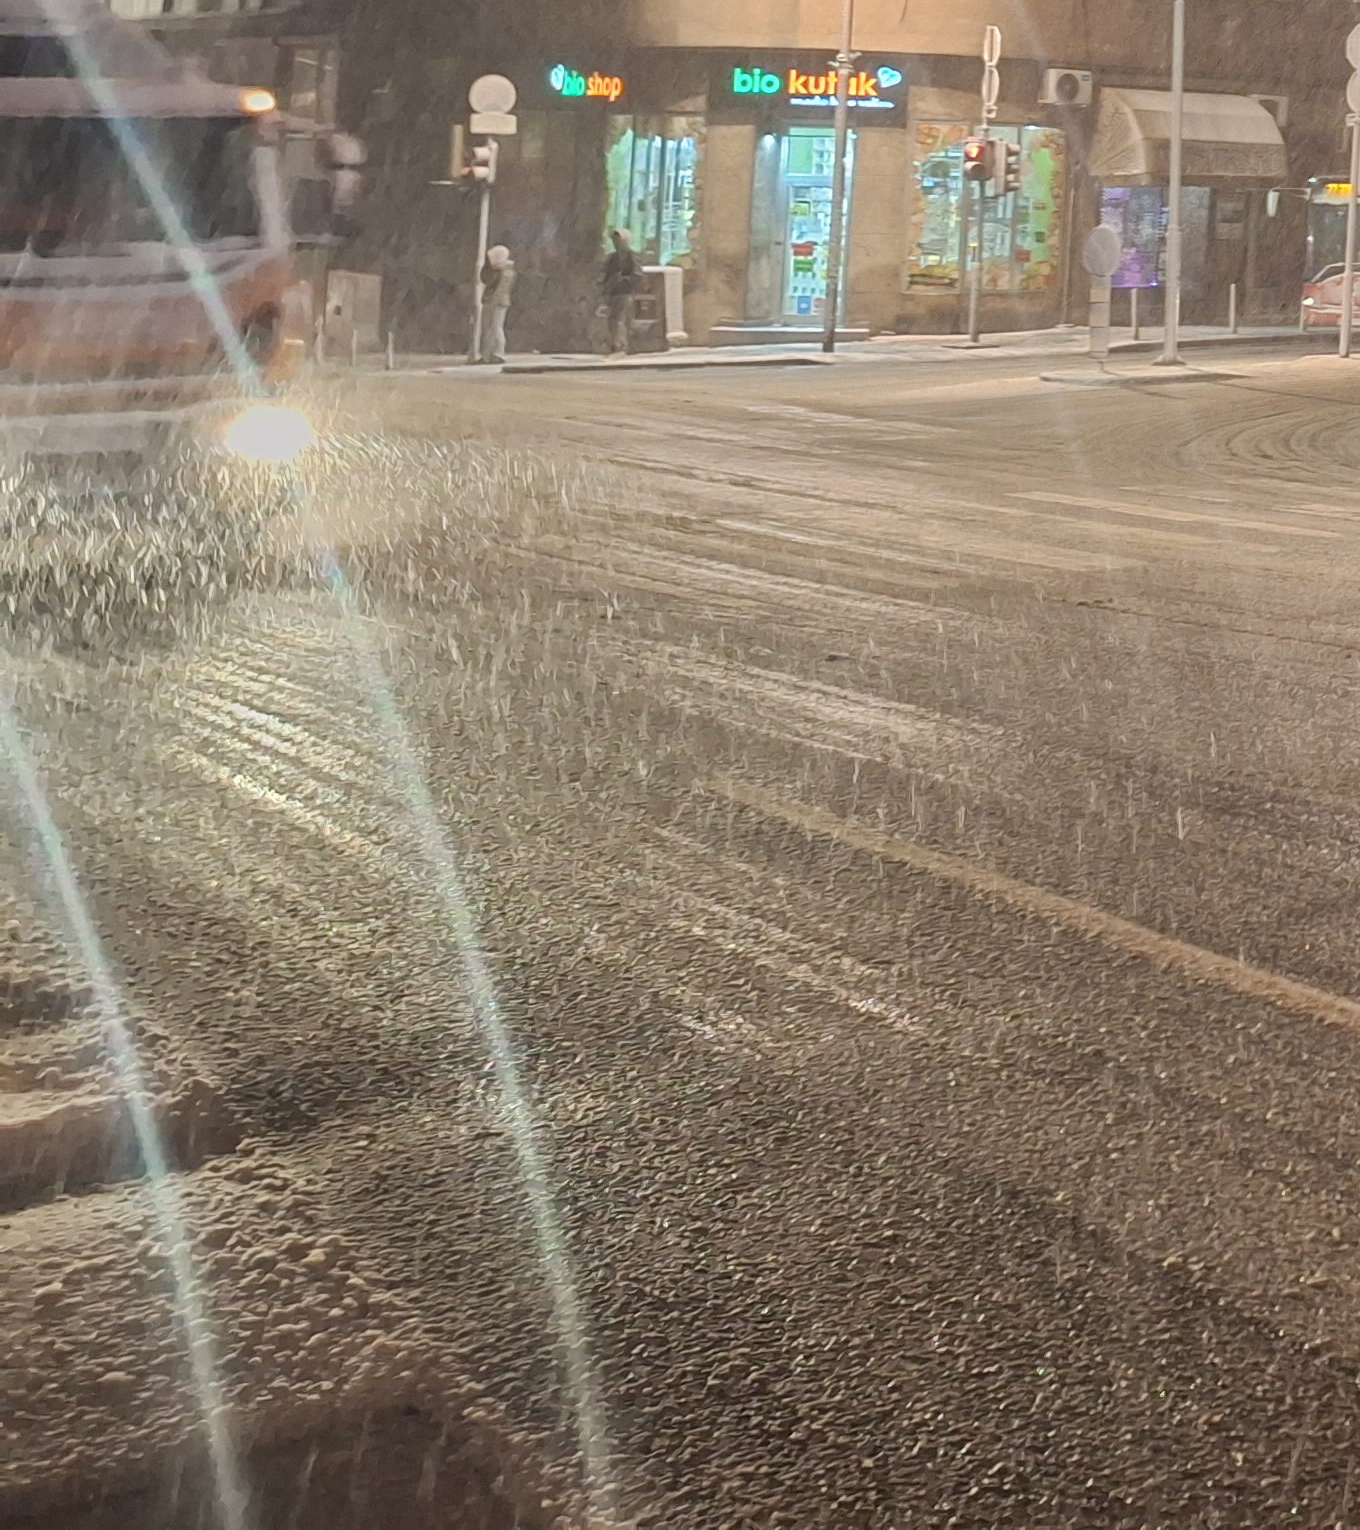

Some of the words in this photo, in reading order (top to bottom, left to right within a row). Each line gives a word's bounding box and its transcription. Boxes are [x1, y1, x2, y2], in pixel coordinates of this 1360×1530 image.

[562, 70, 585, 96] bio
[586, 71, 624, 102] shop
[733, 68, 780, 93] bio
